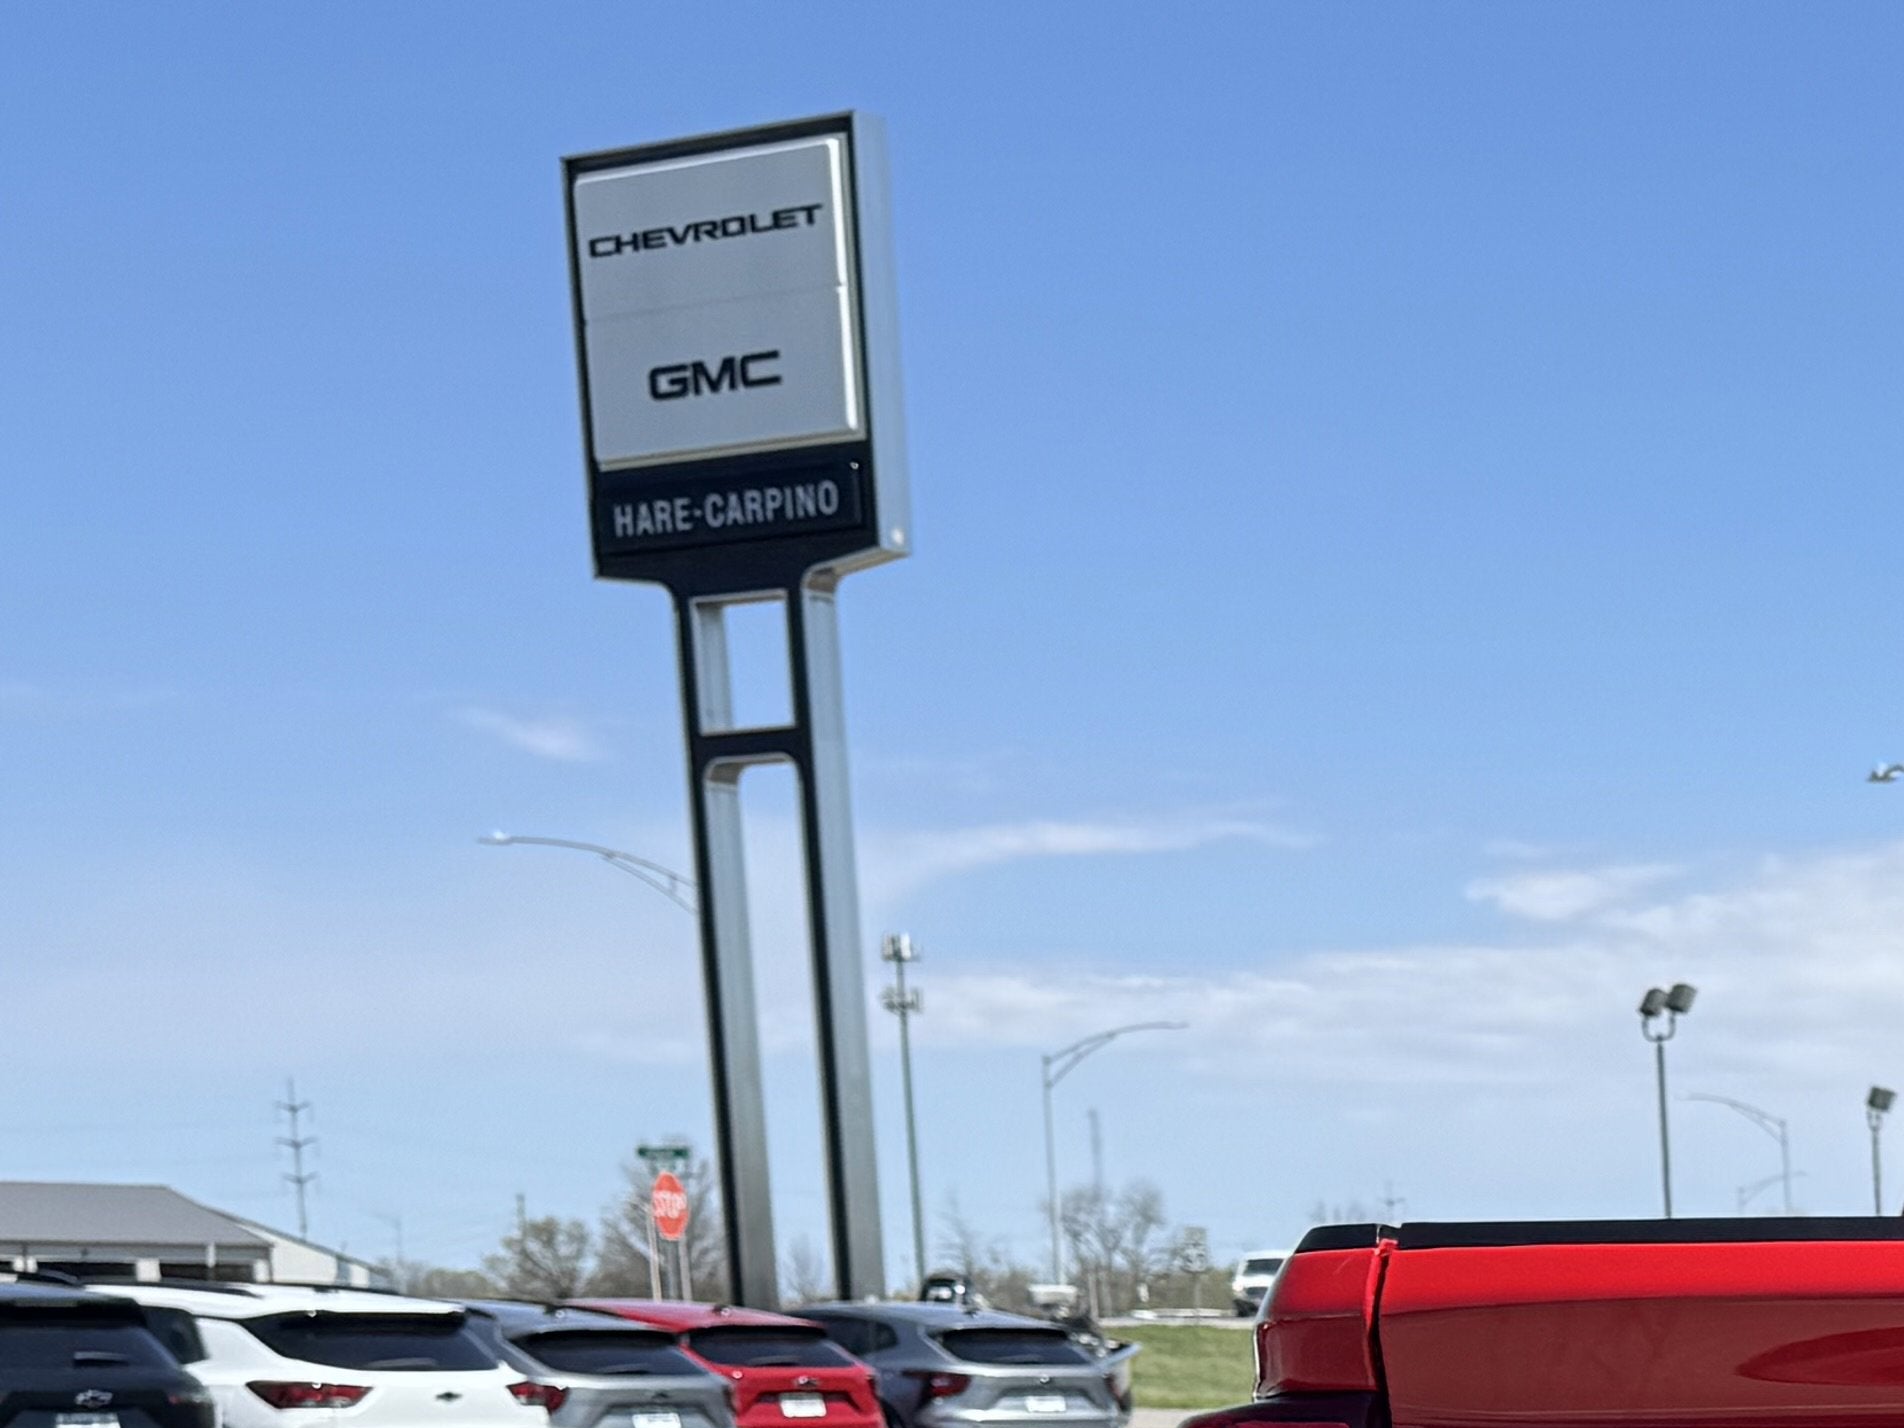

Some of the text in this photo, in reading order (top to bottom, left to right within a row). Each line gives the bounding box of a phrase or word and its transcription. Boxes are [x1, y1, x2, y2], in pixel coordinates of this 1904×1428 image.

[588, 203, 824, 258] CHEVROLET
[648, 349, 782, 401] GMC
[613, 479, 839, 538] HARE-CARPINO
[653, 1190, 687, 1218] STOP
